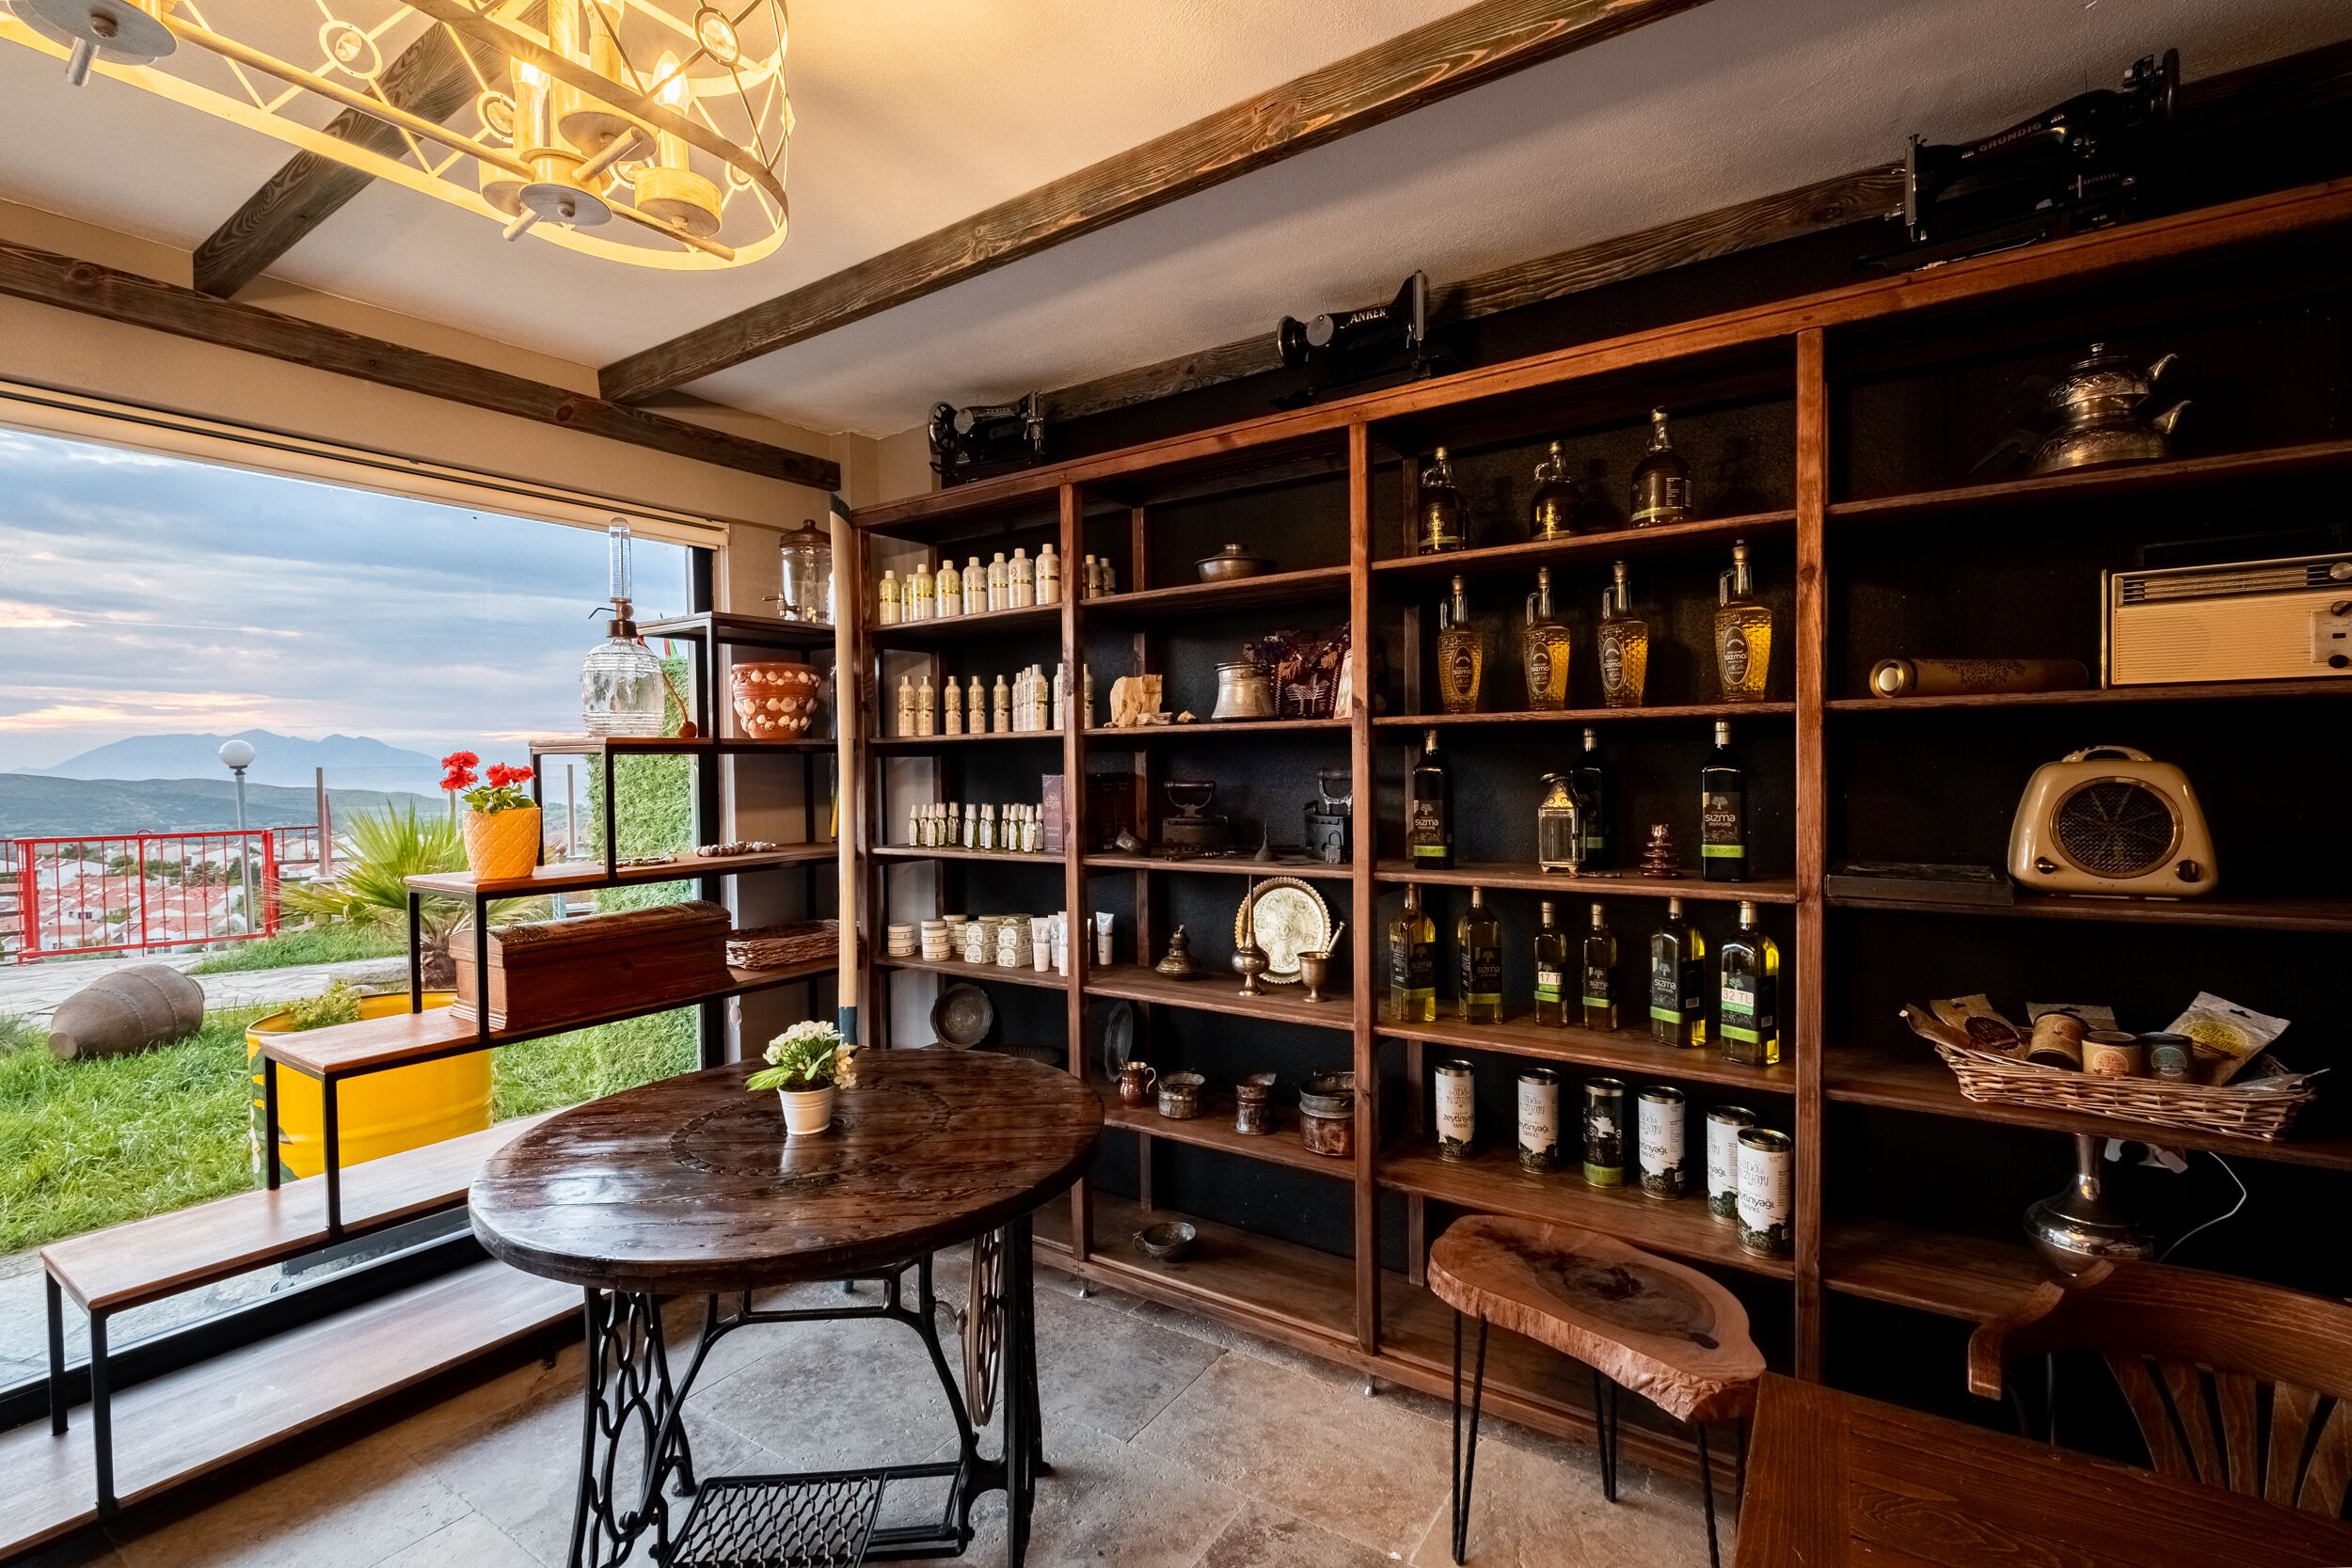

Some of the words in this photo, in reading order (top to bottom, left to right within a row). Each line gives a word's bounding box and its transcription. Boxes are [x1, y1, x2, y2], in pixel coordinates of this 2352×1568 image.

[1979, 121, 2042, 151] GRUNDIG
[1350, 308, 1386, 324] ANKER
[1539, 974, 1550, 982] 17
[1723, 990, 1735, 1001] 32
[1739, 991, 1753, 1005] TL
[1589, 1126, 1622, 1138] sıa
